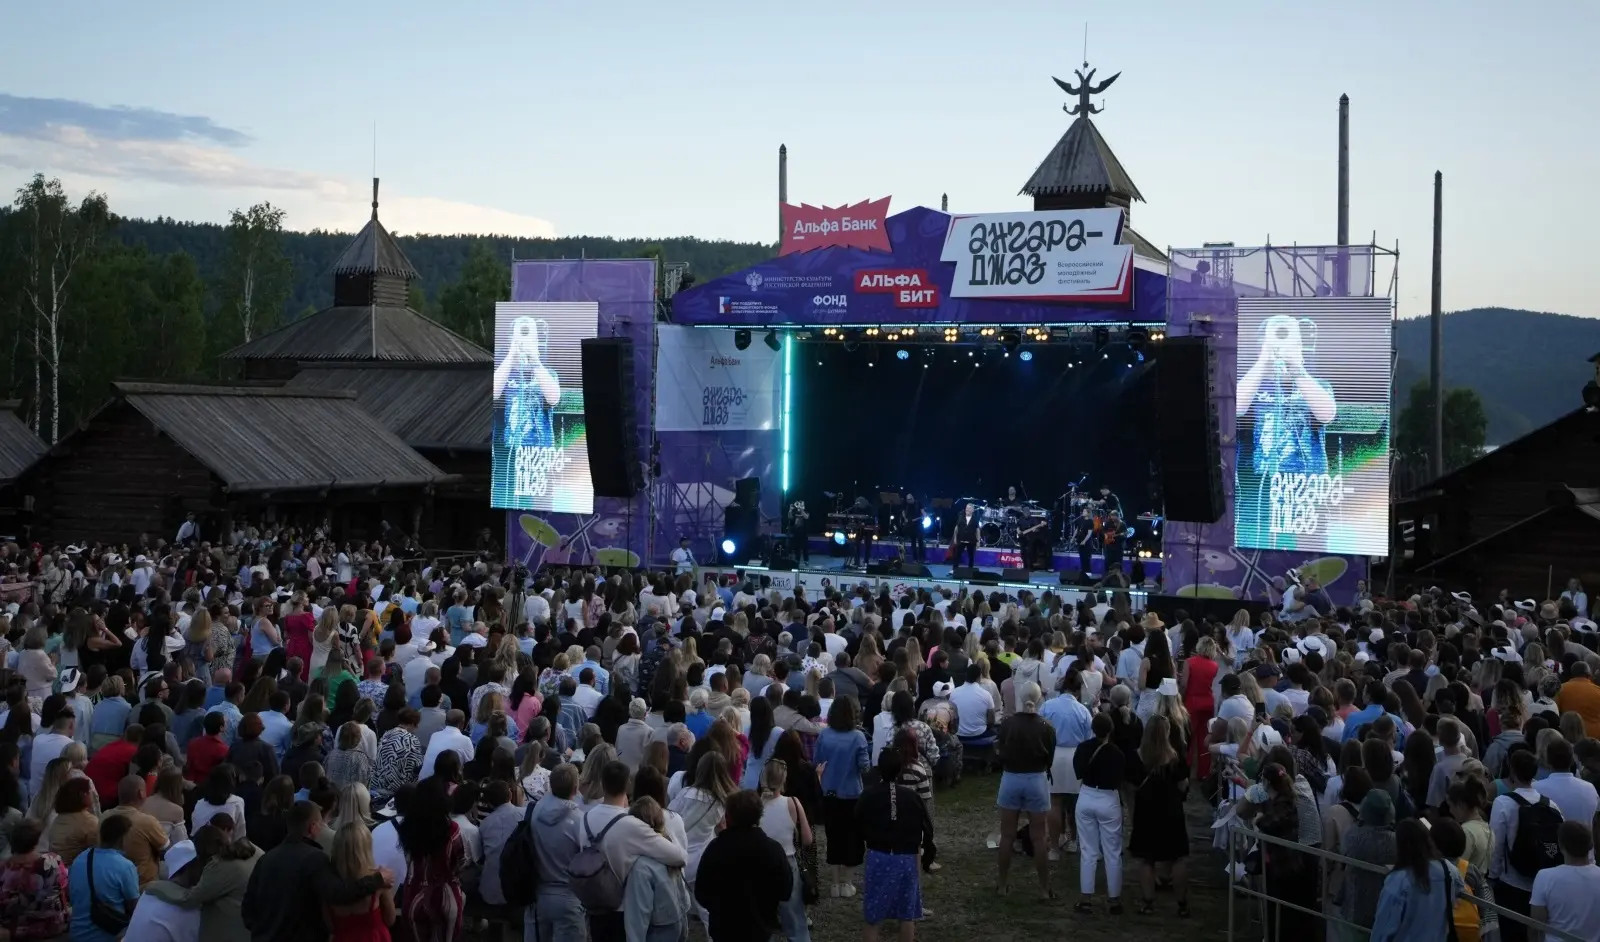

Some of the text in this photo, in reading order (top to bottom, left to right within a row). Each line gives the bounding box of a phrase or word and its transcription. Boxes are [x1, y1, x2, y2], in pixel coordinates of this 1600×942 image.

[793, 217, 877, 235] Альфа Банк
[860, 274, 921, 287] АЛЬФА
[813, 295, 847, 307] ФОНД
[900, 290, 934, 303] БИТ
